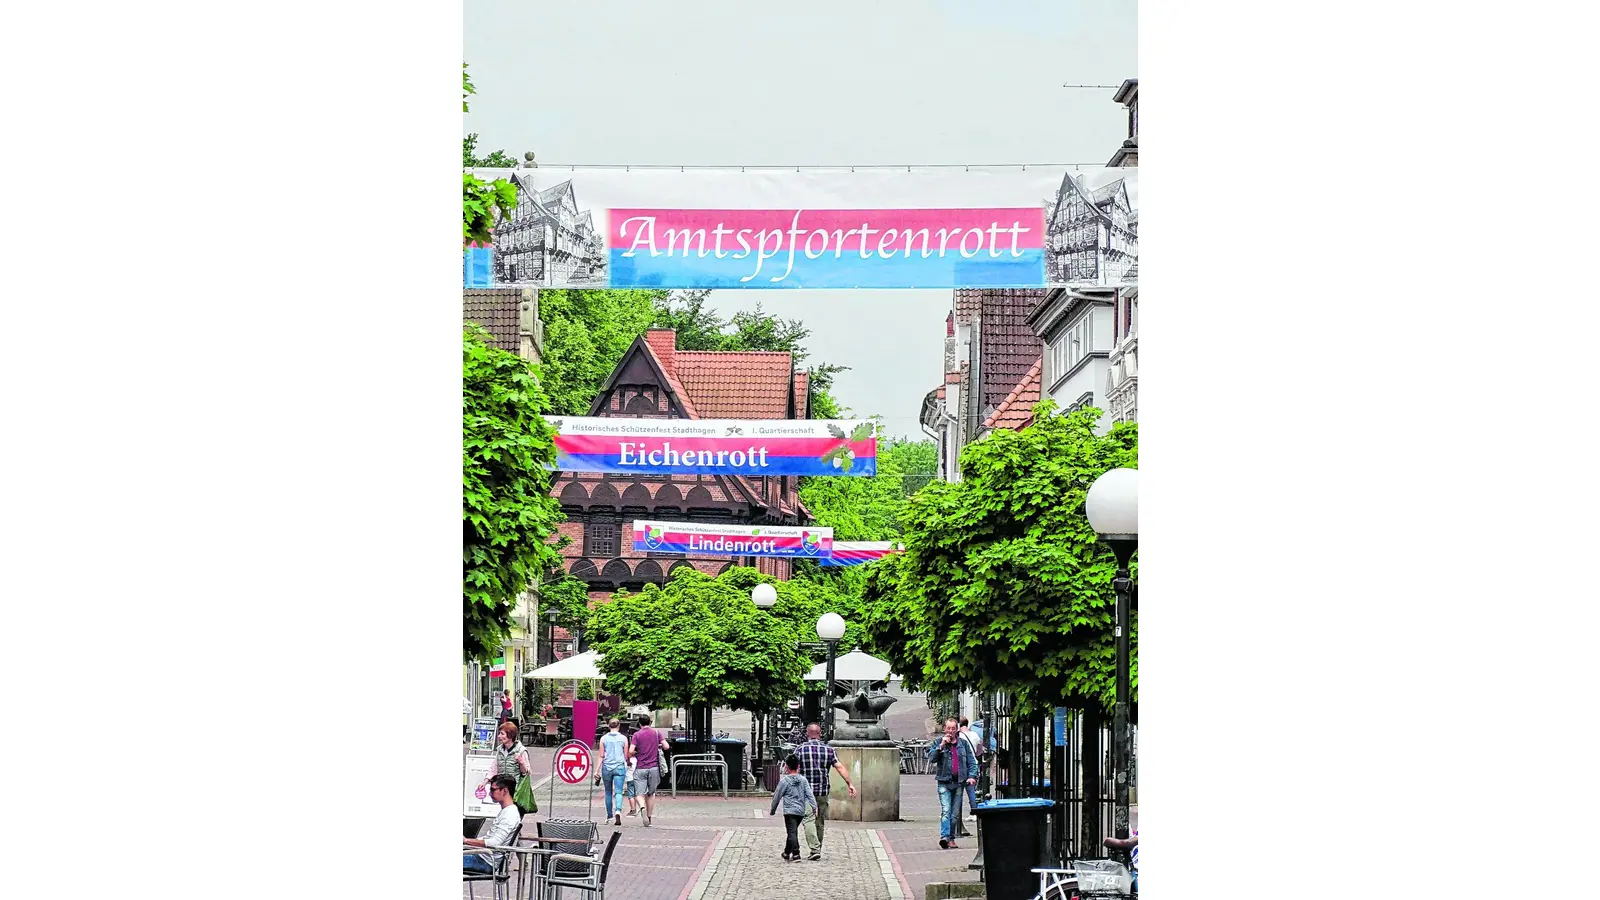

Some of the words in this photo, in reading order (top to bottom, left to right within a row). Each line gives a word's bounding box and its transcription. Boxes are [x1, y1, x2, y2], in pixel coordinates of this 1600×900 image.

[620, 209, 1031, 282] Amtspfortenrott
[572, 424, 620, 433] Historisches
[621, 425, 671, 434] Schützenfest
[672, 426, 716, 435] Stadthagen
[759, 426, 815, 435] Quartierschaft
[617, 441, 769, 468] Eichenrott
[689, 535, 776, 552] Lindenrott
